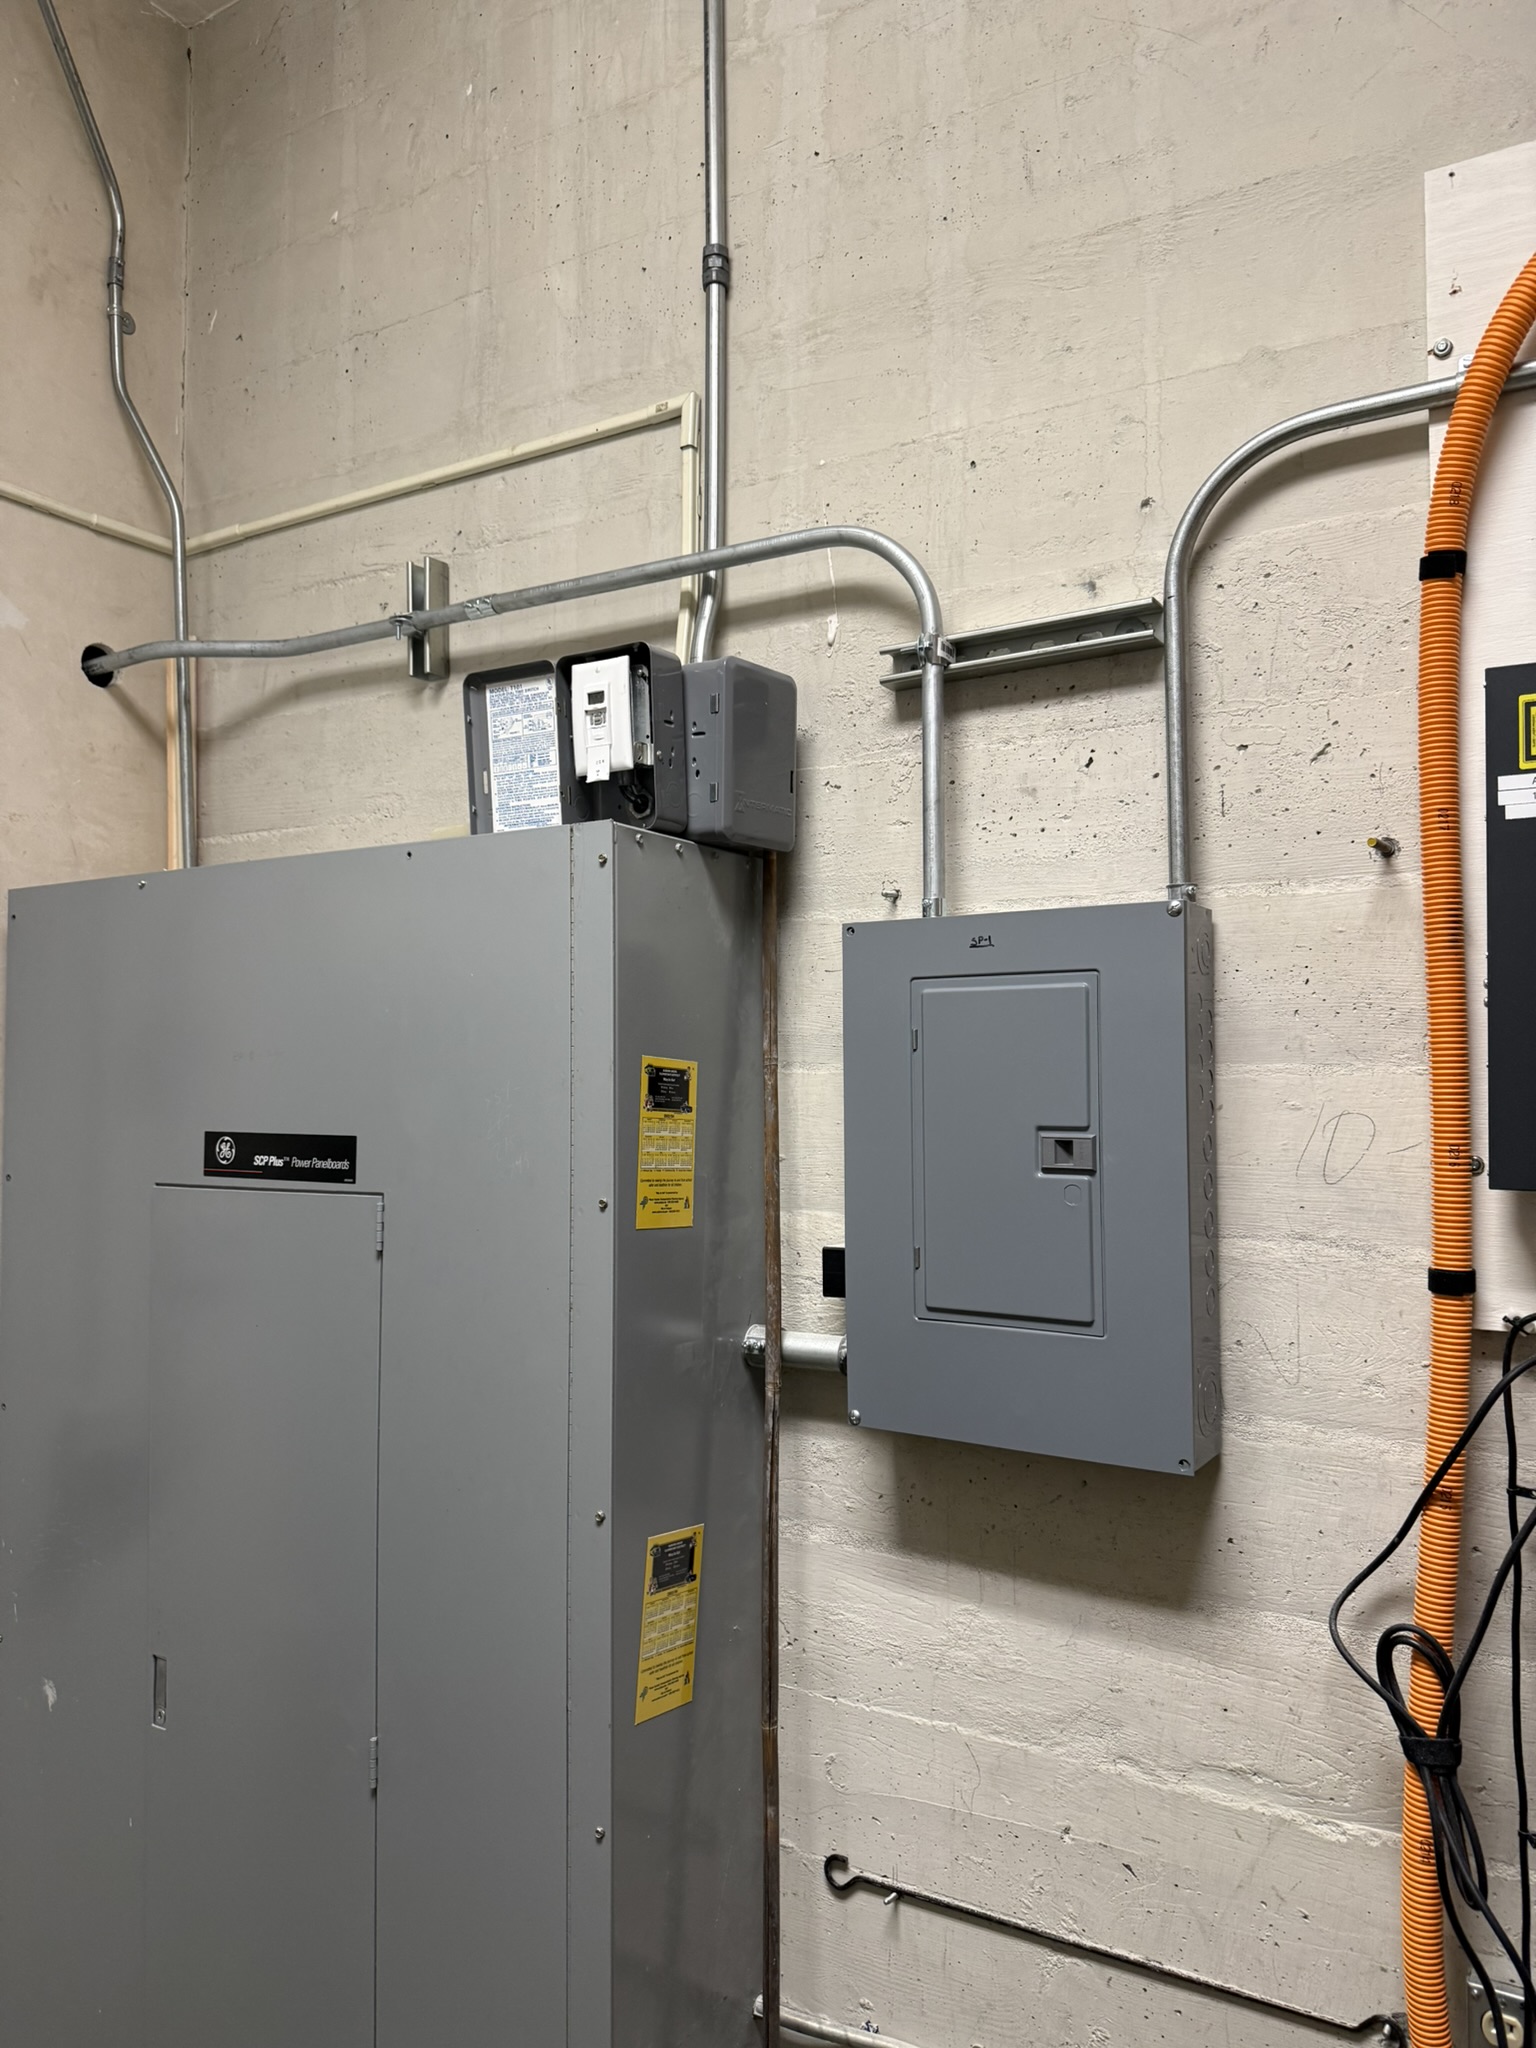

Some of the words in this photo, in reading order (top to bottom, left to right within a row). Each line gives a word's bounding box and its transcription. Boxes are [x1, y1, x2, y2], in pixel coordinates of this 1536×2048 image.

[1449, 481, 1462, 506] 0218
[970, 935, 994, 948] SP-1
[253, 1155, 269, 1166] SCP
[291, 1156, 312, 1168] Power
[311, 1157, 350, 1170] Panelboards
